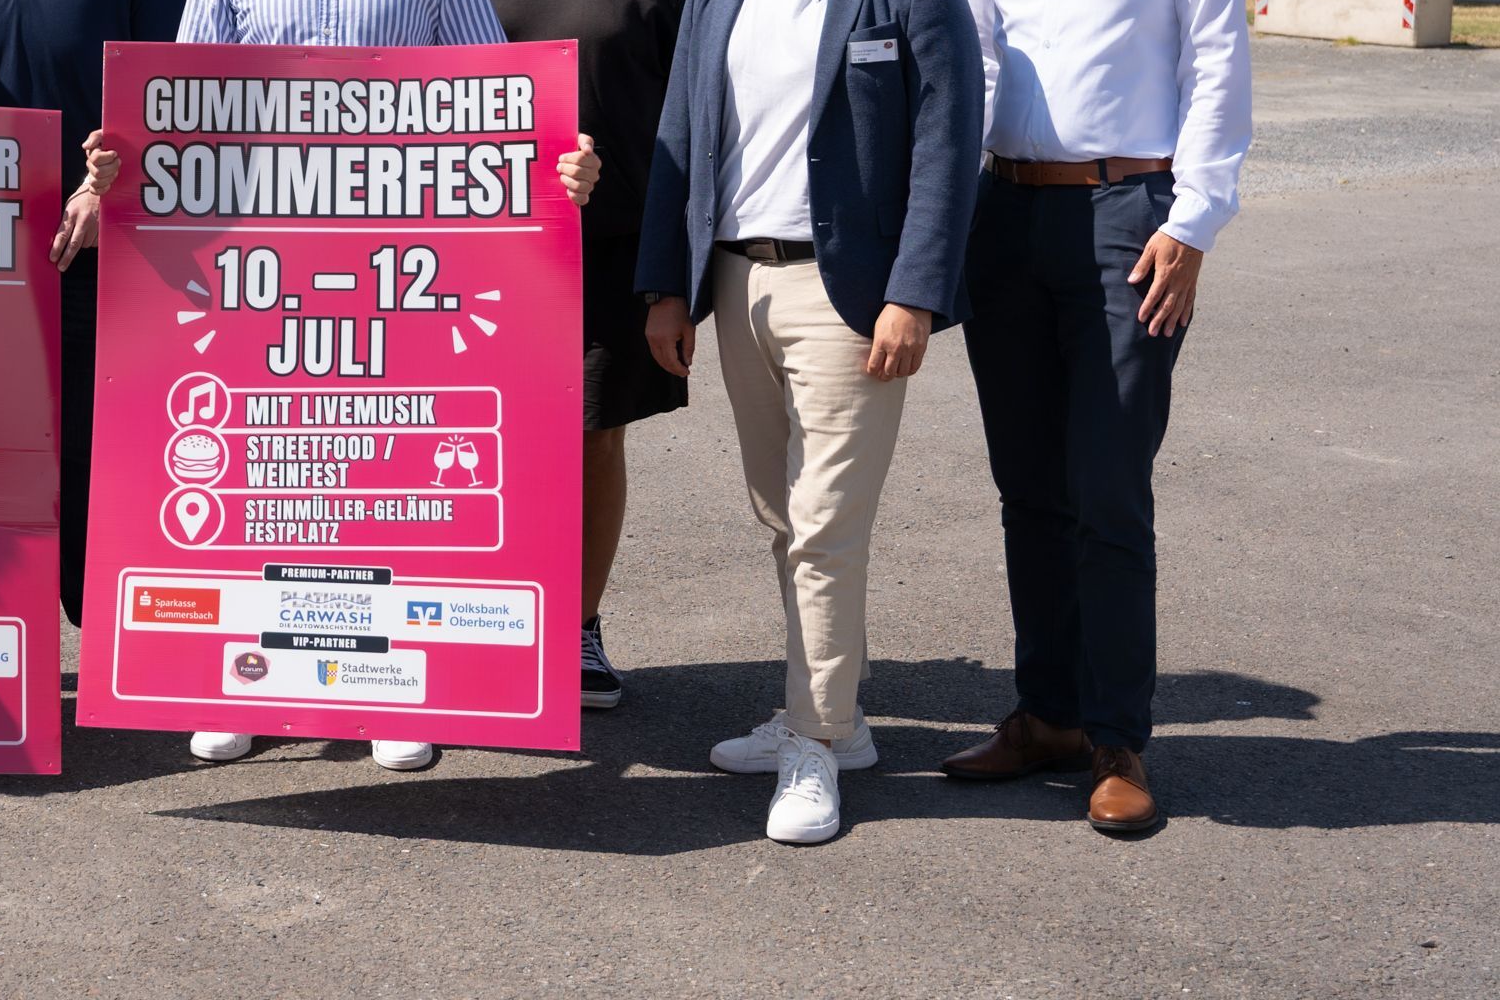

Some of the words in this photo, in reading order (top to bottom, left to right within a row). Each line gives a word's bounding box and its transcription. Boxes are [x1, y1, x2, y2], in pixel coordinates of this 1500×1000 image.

[145, 75, 534, 134] GUMMERSBACHER
[141, 141, 537, 217] SOMMERFEST
[215, 246, 301, 312] 10.
[370, 244, 460, 312] 12.
[267, 317, 386, 377] JULI
[246, 396, 293, 425] MIT
[301, 394, 436, 425] LIVEMUSIK
[246, 435, 377, 461] STREETFOOD
[246, 462, 349, 488] WEINFEST
[245, 496, 453, 521] STEINMÜLLER-GELÄNDE
[245, 521, 339, 543] FESTPLATZ
[281, 567, 374, 581] PREMIUM-PARTNER
[155, 598, 197, 611] Sparkasse
[450, 603, 509, 615] Volksbank
[154, 609, 213, 620] Gummersbach
[280, 610, 372, 624] CARWASH
[450, 616, 506, 631] Oberberg
[509, 619, 525, 630] eG
[293, 636, 357, 649] VIP-PARTNER
[342, 663, 402, 675] Stadtwerke
[341, 674, 418, 687] Gummersbach
